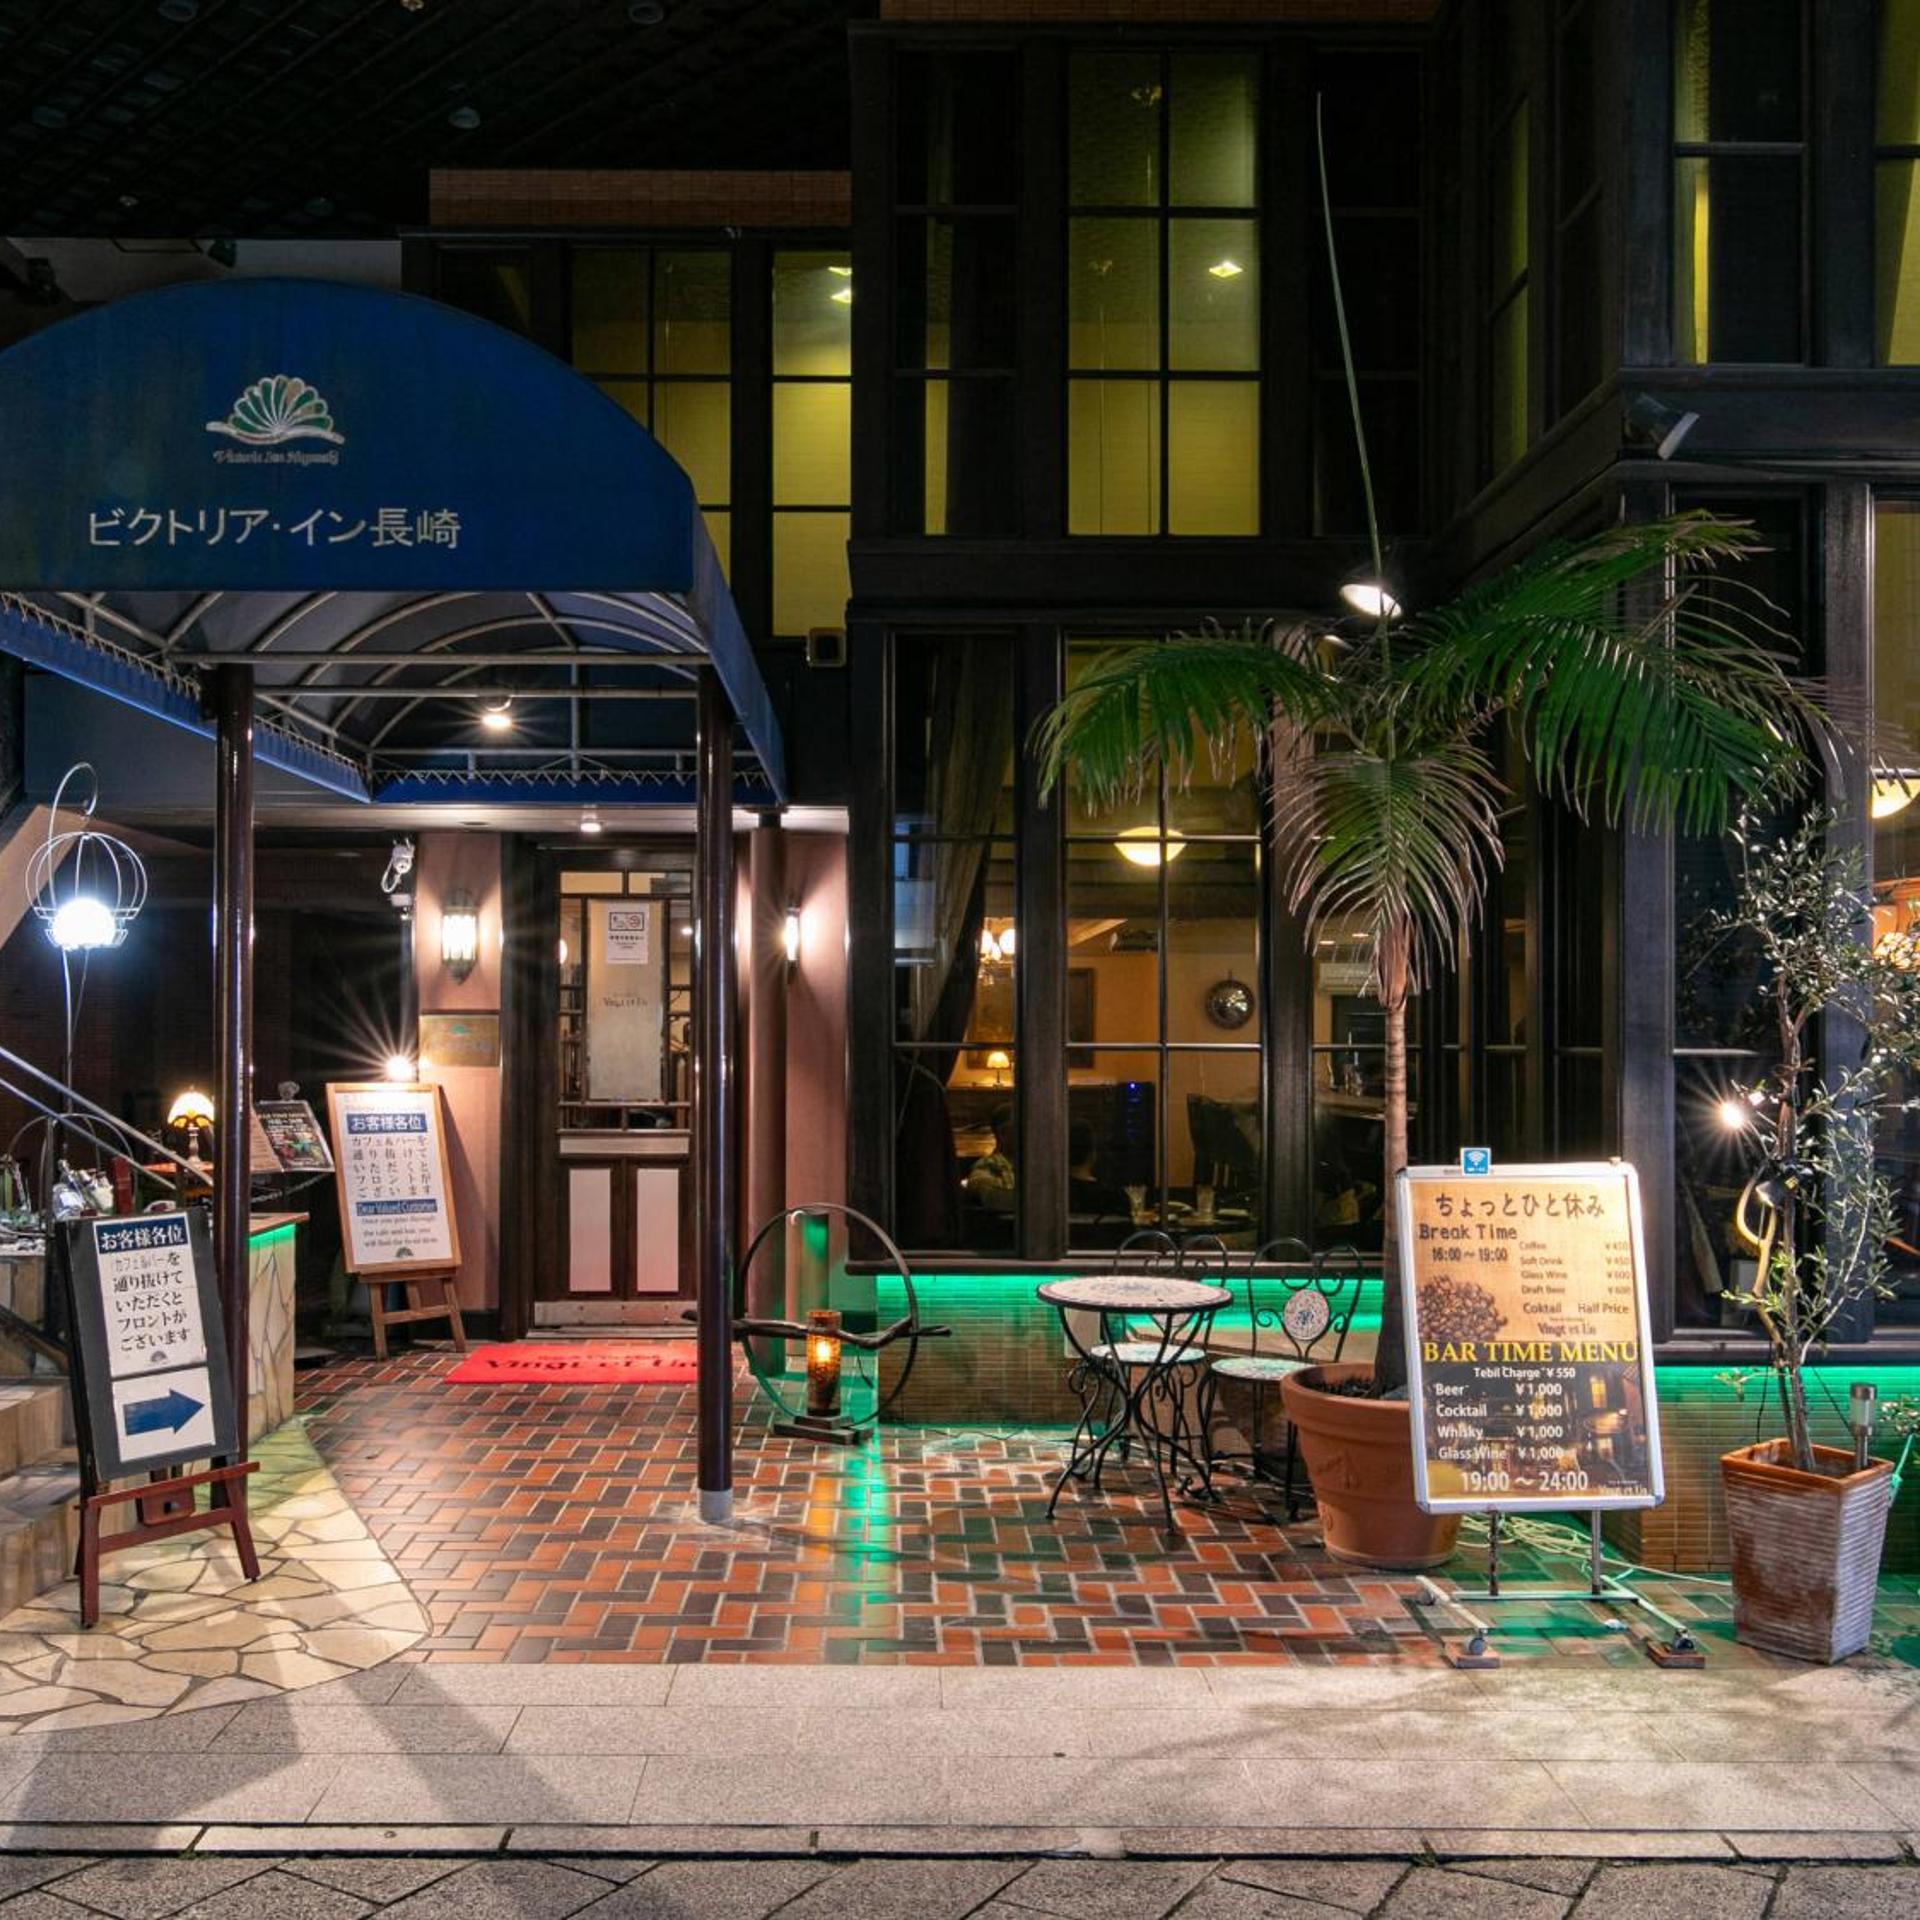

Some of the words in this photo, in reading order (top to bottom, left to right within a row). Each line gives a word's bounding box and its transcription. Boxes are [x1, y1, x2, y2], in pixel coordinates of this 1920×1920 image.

[1436, 1192, 1604, 1218] ちょっとひと休み
[101, 1224, 184, 1250] お客様各位
[1418, 1223, 1471, 1240] Break
[1476, 1223, 1518, 1240] Time
[113, 1270, 183, 1292] 通り抜けて
[116, 1292, 183, 1311] いただくと
[1523, 1302, 1562, 1314] Coktail
[1578, 1302, 1600, 1313] Half
[1602, 1303, 1629, 1314] Price
[118, 1310, 188, 1331] フロントが
[121, 1328, 190, 1351] ございます
[1423, 1342, 1477, 1362] BAR
[1483, 1342, 1553, 1362] TIME
[1560, 1341, 1639, 1362] MENU
[1502, 1367, 1540, 1380] Charge
[1435, 1383, 1464, 1395] Beer
[1436, 1403, 1487, 1417] Cocktail
[1437, 1425, 1484, 1440] Whisky
[1438, 1448, 1471, 1460] Glass
[1474, 1448, 1506, 1460] Wine
